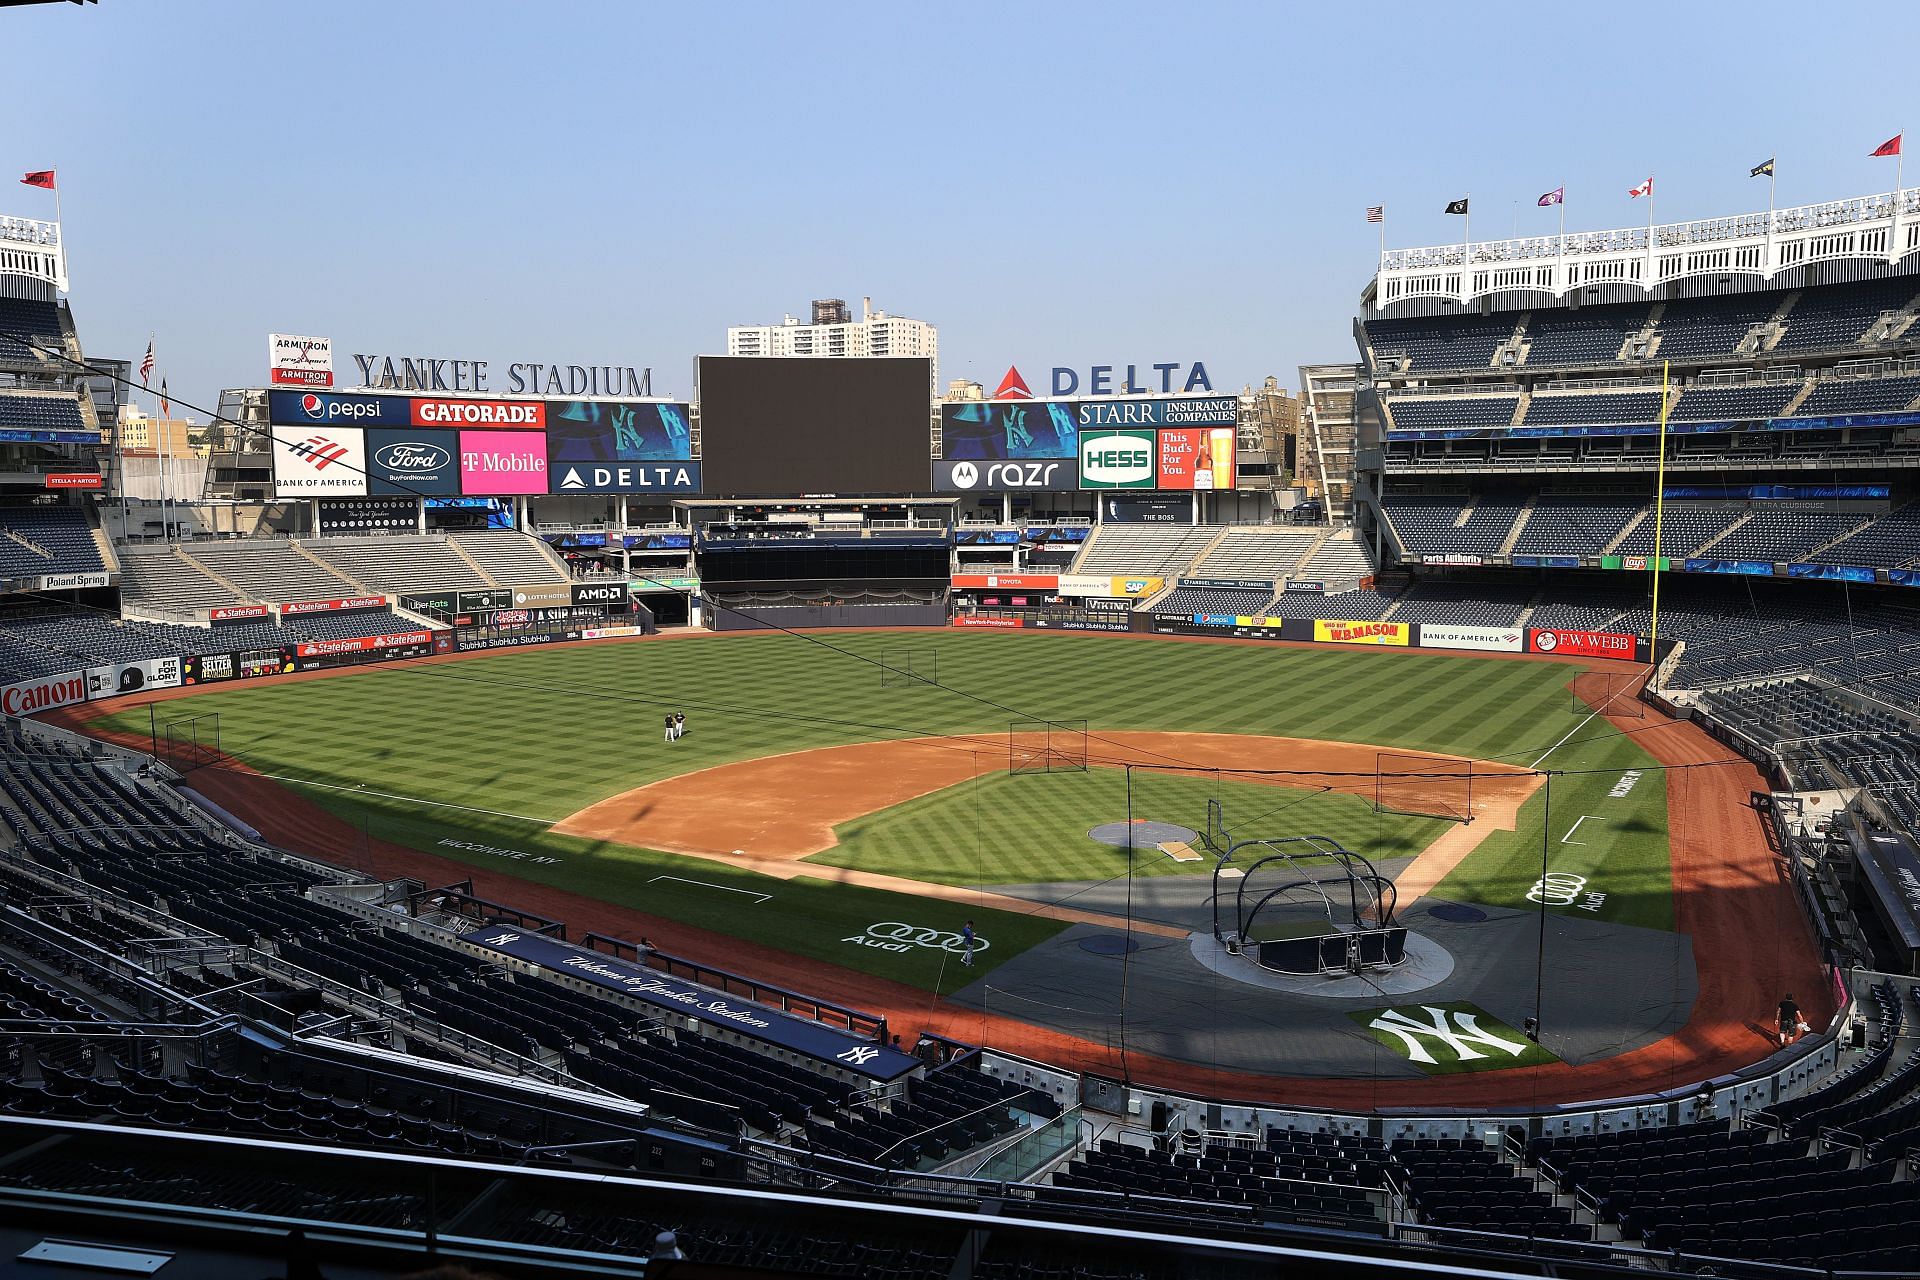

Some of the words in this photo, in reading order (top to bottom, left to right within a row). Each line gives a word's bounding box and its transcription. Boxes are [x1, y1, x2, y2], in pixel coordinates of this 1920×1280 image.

[276, 339, 328, 351] ARMITRON
[281, 370, 327, 381] ARMITRON
[353, 354, 489, 392] YANKEE
[508, 363, 653, 397] STADIUM
[1052, 361, 1213, 396] DELTA
[328, 401, 382, 420] pepsi
[1166, 400, 1237, 413] INSURANCE
[420, 403, 538, 424] GATORADE
[1079, 403, 1158, 425] STARR
[1166, 411, 1236, 422] COMPANIES
[1162, 432, 1187, 442] This
[1162, 443, 1192, 453] Bud's
[388, 446, 437, 469] Ford
[482, 452, 545, 473] Mobile
[1087, 450, 1148, 468] HESS
[1162, 454, 1181, 464] For
[987, 463, 1059, 487] razr
[1162, 464, 1186, 475] You.
[276, 479, 303, 487] BANK
[306, 479, 318, 487] OF
[320, 479, 364, 487] AMERICA
[389, 474, 438, 482] BuyFordNow.com
[594, 467, 692, 487] DELTA
[1423, 554, 1444, 562] Parts
[1444, 553, 1482, 563] Authority
[47, 576, 76, 588] Poland
[78, 575, 105, 587] Spring
[1125, 583, 1144, 592] SAP
[578, 589, 609, 600] AMD
[1044, 595, 1064, 603] FedEx
[1210, 617, 1229, 625] pepsi
[459, 640, 487, 651] StubHub
[489, 637, 518, 647] StubHub
[520, 634, 550, 644] StubHub
[1460, 634, 1500, 643] AMERICA
[1559, 633, 1584, 646] F.W.
[1587, 635, 1629, 650] WEBB
[162, 660, 176, 668] FIT
[201, 659, 232, 671] SELTZER
[146, 673, 177, 682] GLORY
[2, 677, 83, 715] Canon
[1577, 891, 1607, 912] Audi
[841, 935, 914, 953] Audi
[562, 955, 625, 982] Welcome
[622, 976, 643, 986] to
[627, 980, 699, 1005] Yankee
[696, 1000, 770, 1029] Stadium
